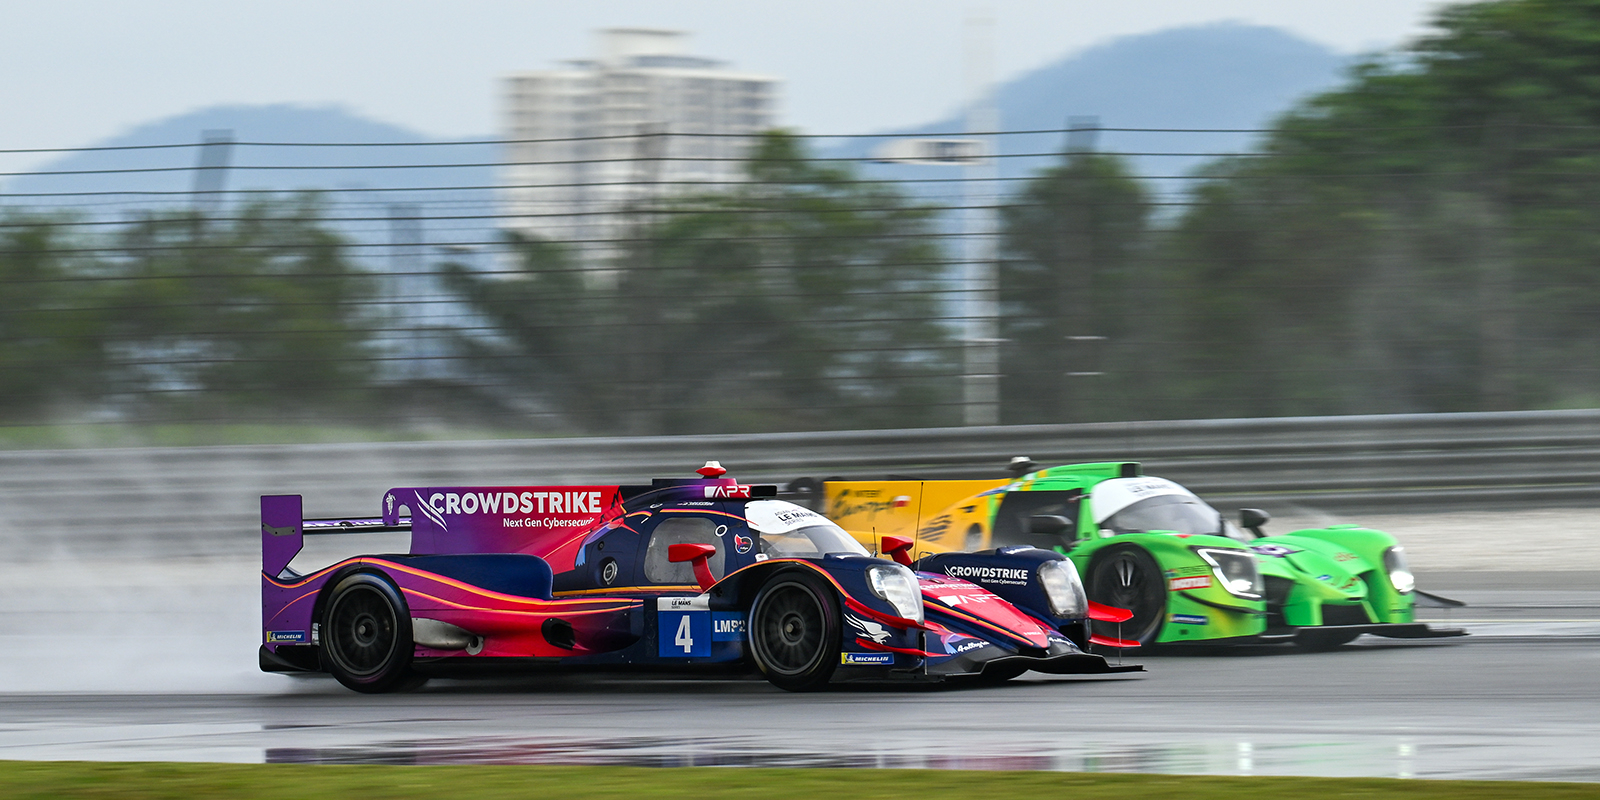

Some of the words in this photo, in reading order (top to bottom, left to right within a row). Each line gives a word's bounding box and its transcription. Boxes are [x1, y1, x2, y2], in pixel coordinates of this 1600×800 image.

[714, 485, 750, 498] APR
[429, 492, 602, 515] CROWDSTRIKE
[503, 518, 524, 528] Next
[524, 518, 542, 528] Gen
[778, 513, 793, 522] LE
[791, 511, 818, 519] MANS
[949, 566, 1029, 580] CROWDSTRIKE
[999, 578, 1028, 587] Cybersecurity
[714, 620, 746, 633] LMP2
[675, 615, 693, 654] 4
